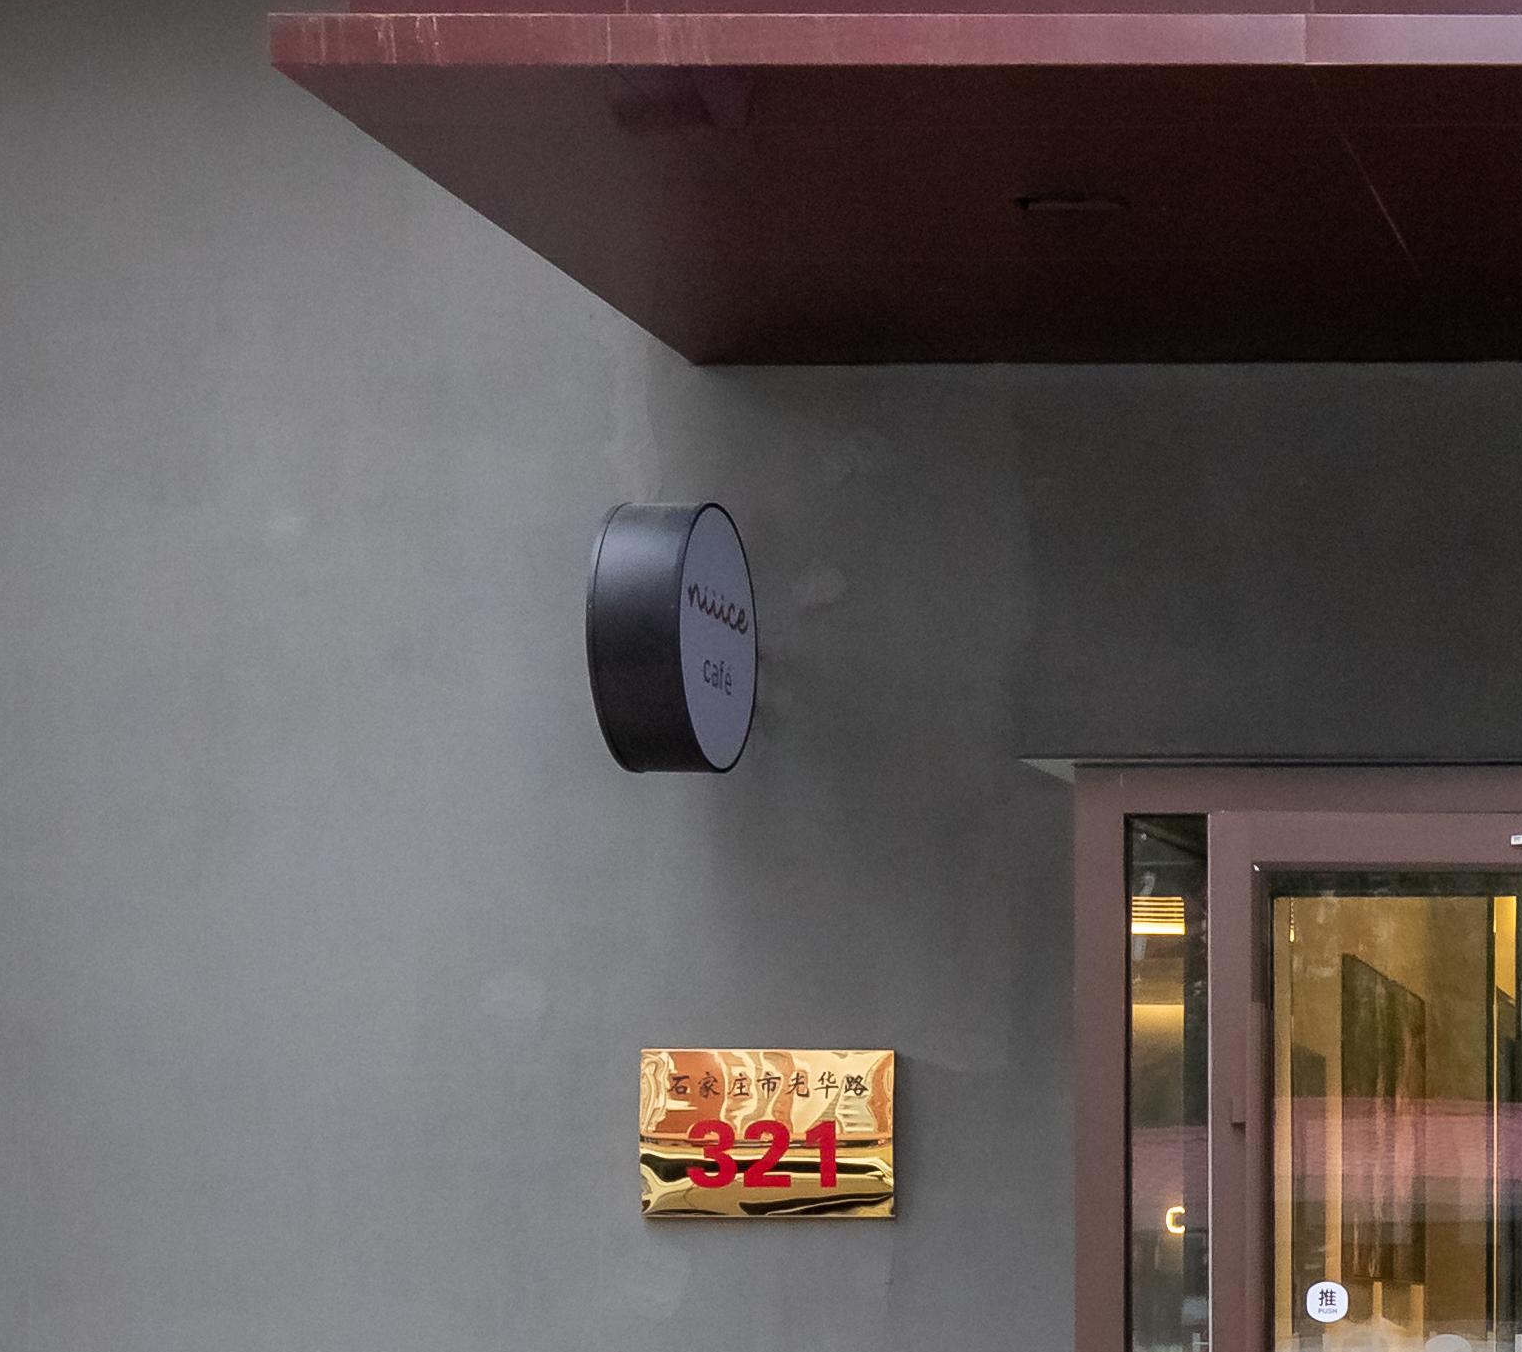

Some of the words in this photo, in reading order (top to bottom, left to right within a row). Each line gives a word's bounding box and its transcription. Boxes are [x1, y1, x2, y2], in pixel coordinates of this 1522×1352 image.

[667, 1071, 869, 1100] 石家庄市光华路
[687, 1119, 838, 1188] 321
[1318, 1288, 1337, 1307] 推
